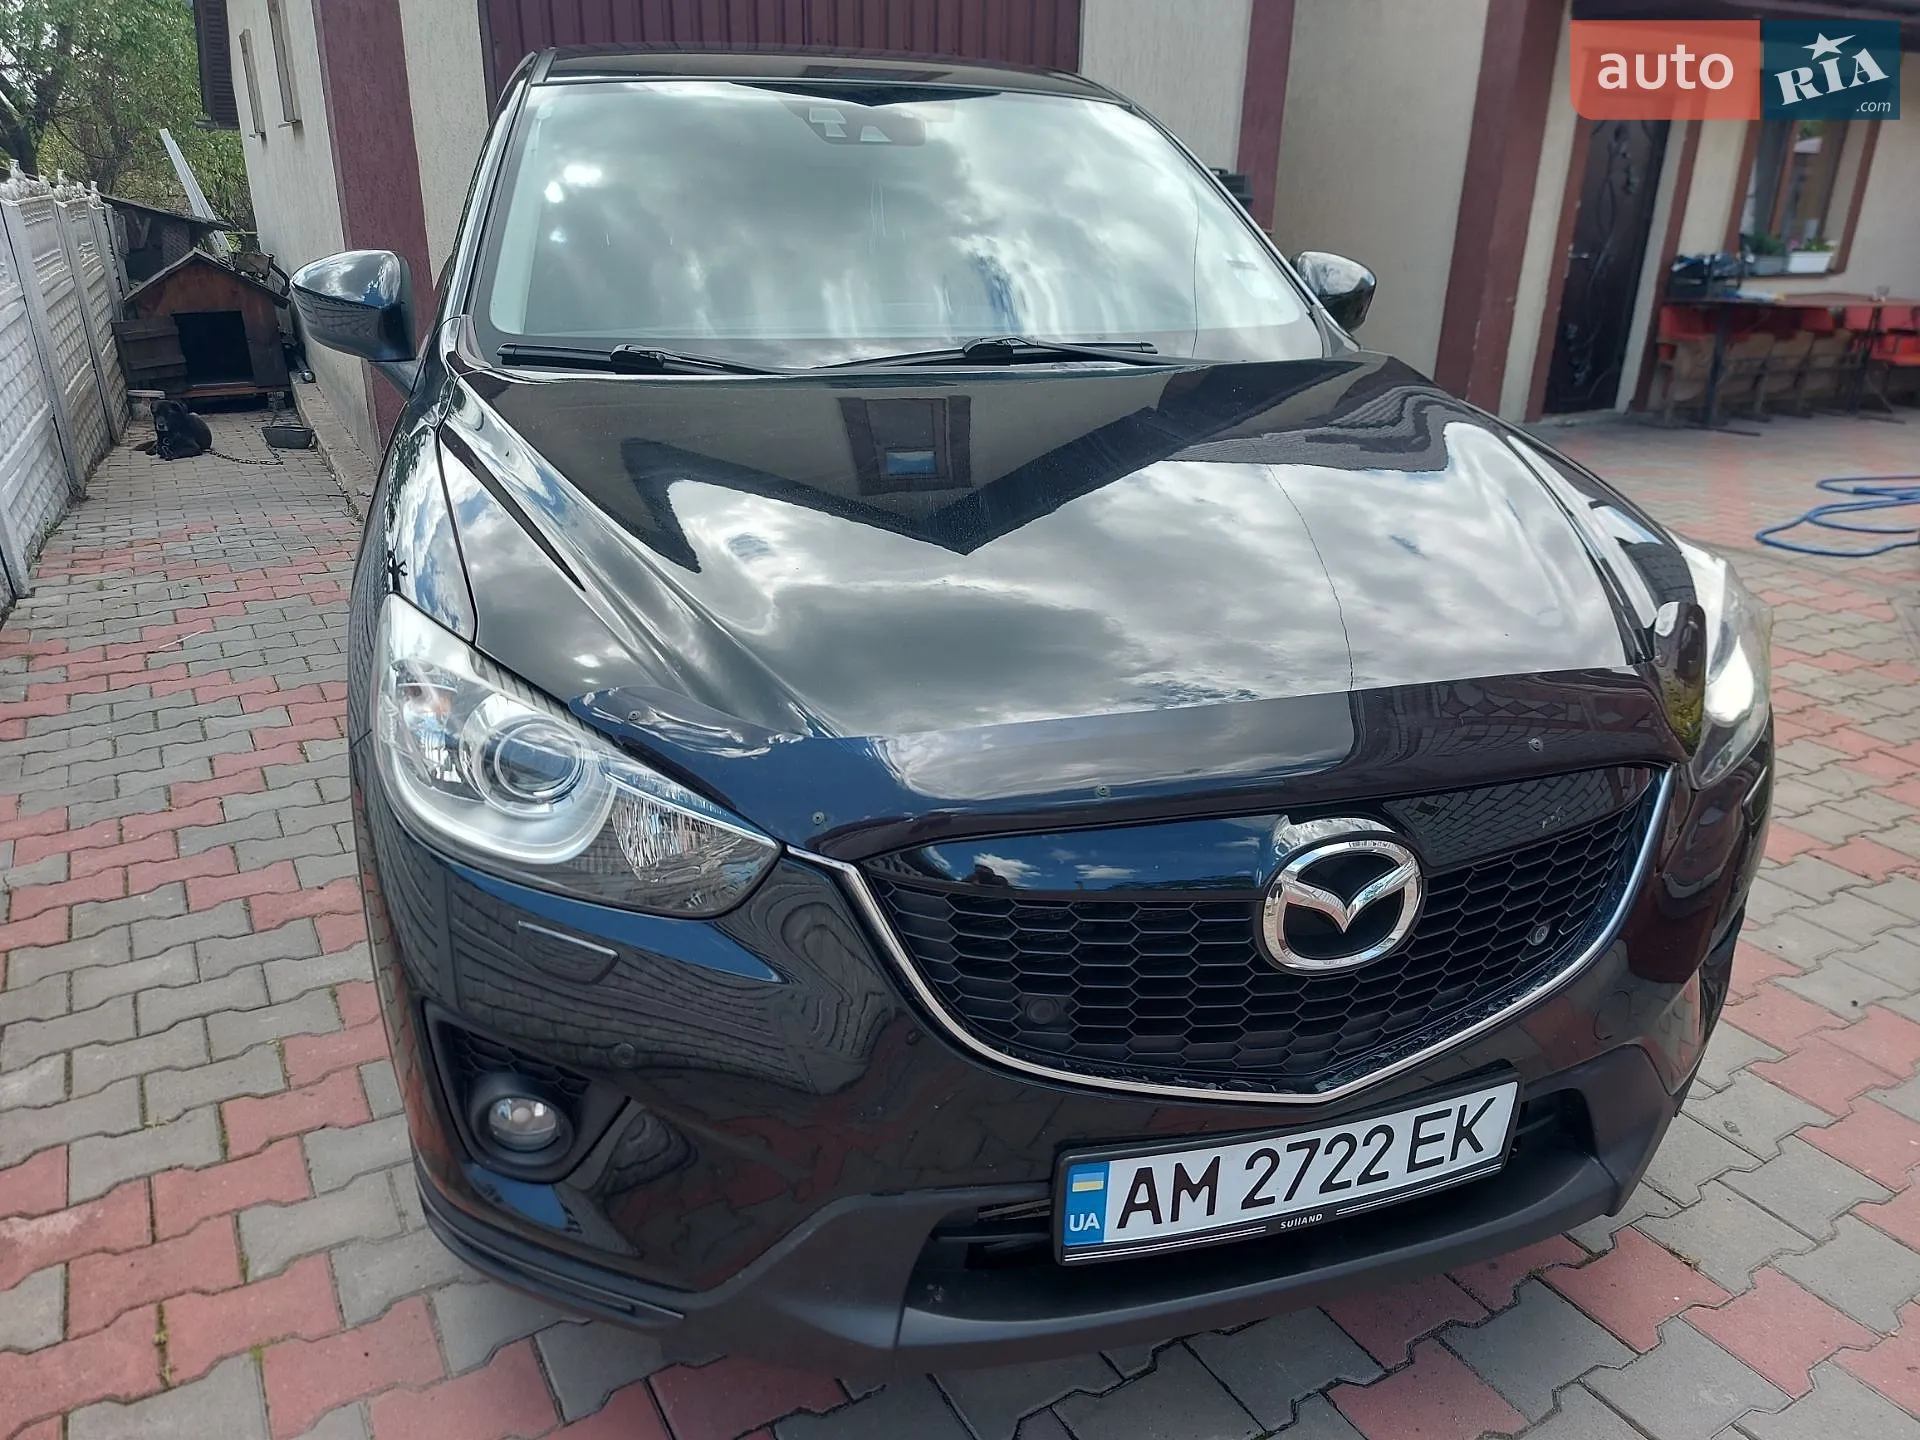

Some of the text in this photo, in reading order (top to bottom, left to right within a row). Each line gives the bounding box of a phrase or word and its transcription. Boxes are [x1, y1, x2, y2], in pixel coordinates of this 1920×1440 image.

[1117, 1097, 1497, 1229] AM 2722 EK
[1069, 1212, 1101, 1232] UA
